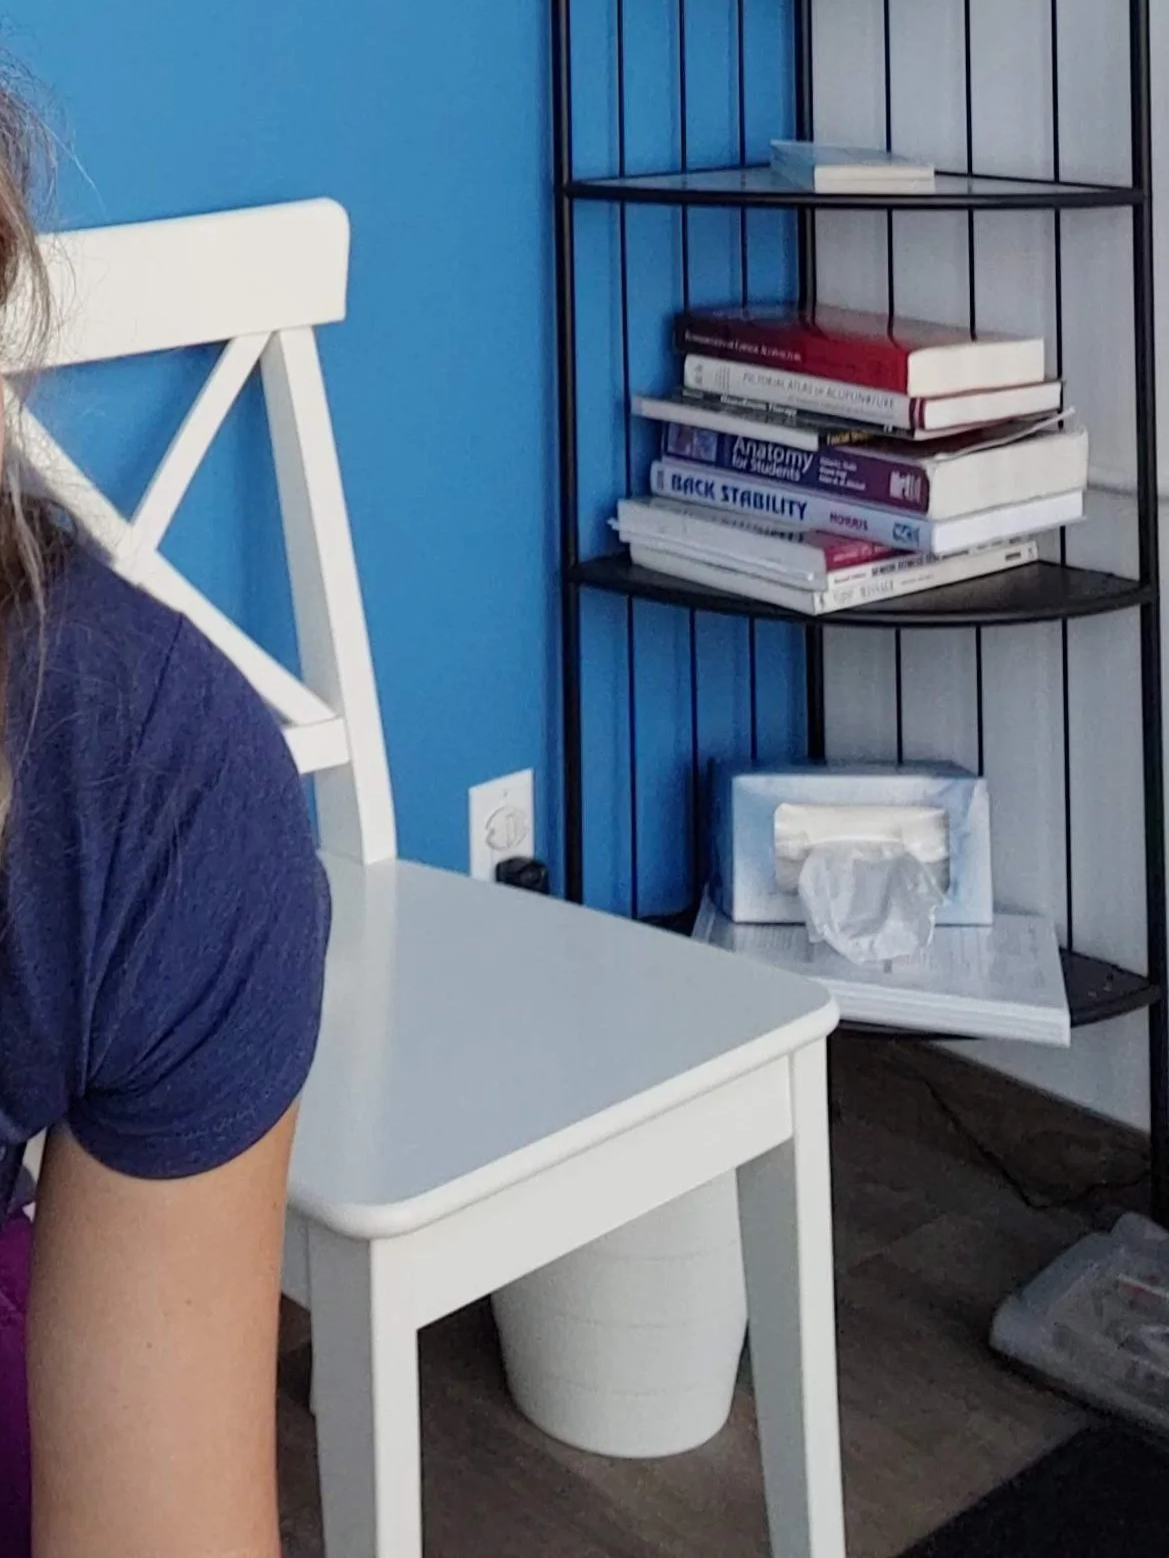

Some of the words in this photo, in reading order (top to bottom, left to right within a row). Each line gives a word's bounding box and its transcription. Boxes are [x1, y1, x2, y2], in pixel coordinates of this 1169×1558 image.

[732, 453, 748, 470] for
[748, 457, 802, 483] Students
[733, 436, 816, 475] Anatomy
[671, 473, 717, 502] BACK
[720, 484, 808, 521] STABILITY
